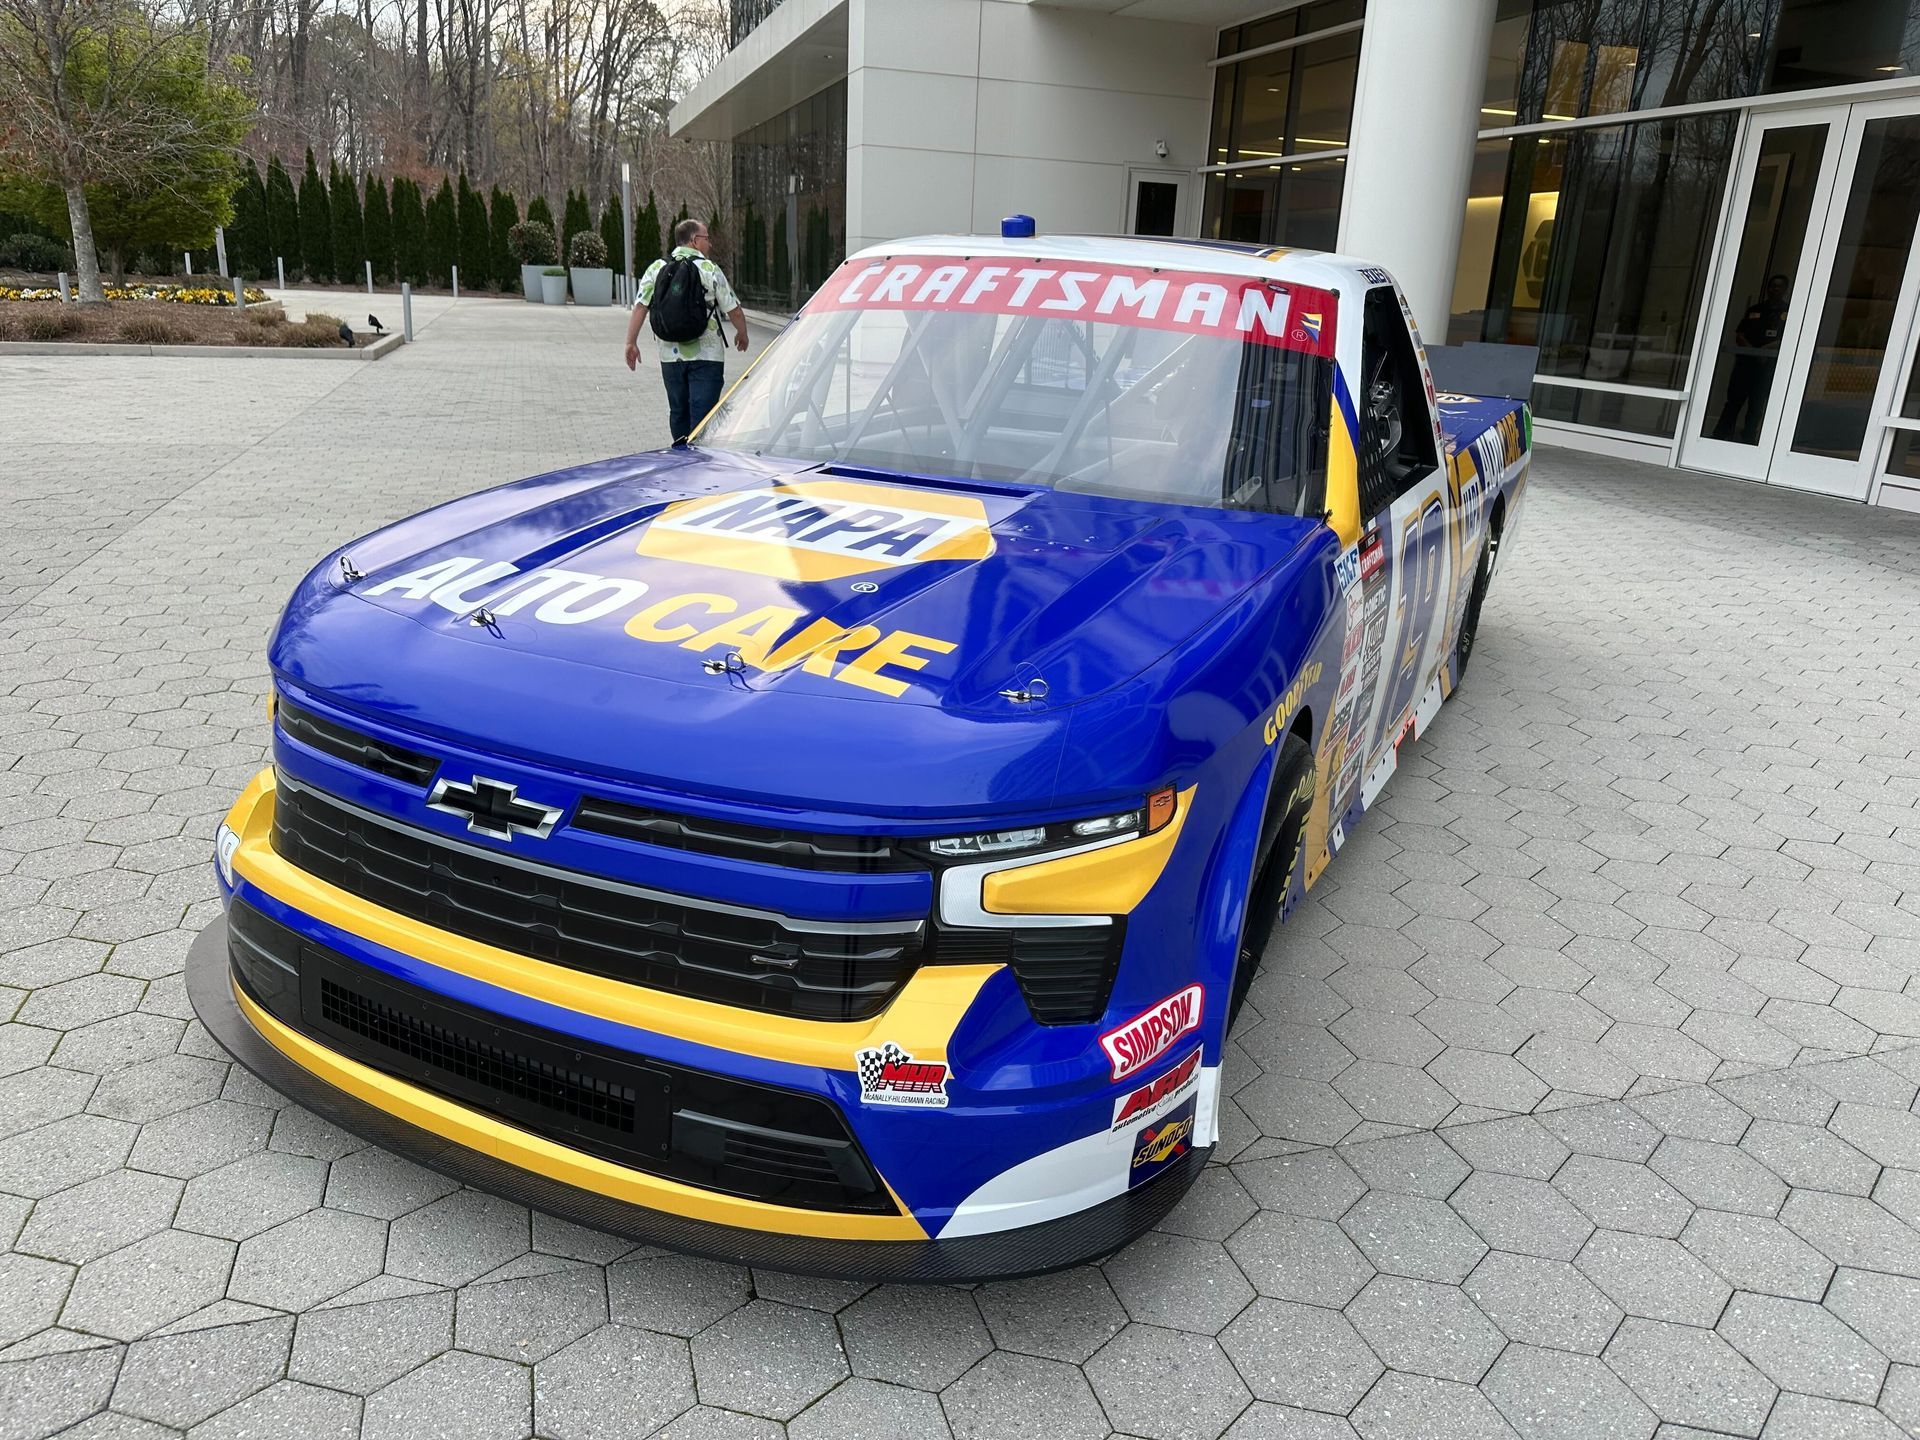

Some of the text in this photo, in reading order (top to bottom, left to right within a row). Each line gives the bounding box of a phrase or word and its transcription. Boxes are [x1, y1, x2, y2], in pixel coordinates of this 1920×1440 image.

[838, 266, 1290, 338] CRAFTSMAN
[697, 495, 951, 557] NAPA
[1336, 547, 1358, 592] SKF
[361, 556, 959, 697] AUTO CARE
[1263, 660, 1323, 746] GOODYEAR
[1113, 992, 1193, 1073] SIMPSON
[863, 1093, 946, 1106] McANALLY-HILGEMANN RACING
[1112, 1073, 1199, 1133] automotive products
[1115, 1049, 1200, 1123] ARP
[1139, 1119, 1192, 1163] SUNOCO
